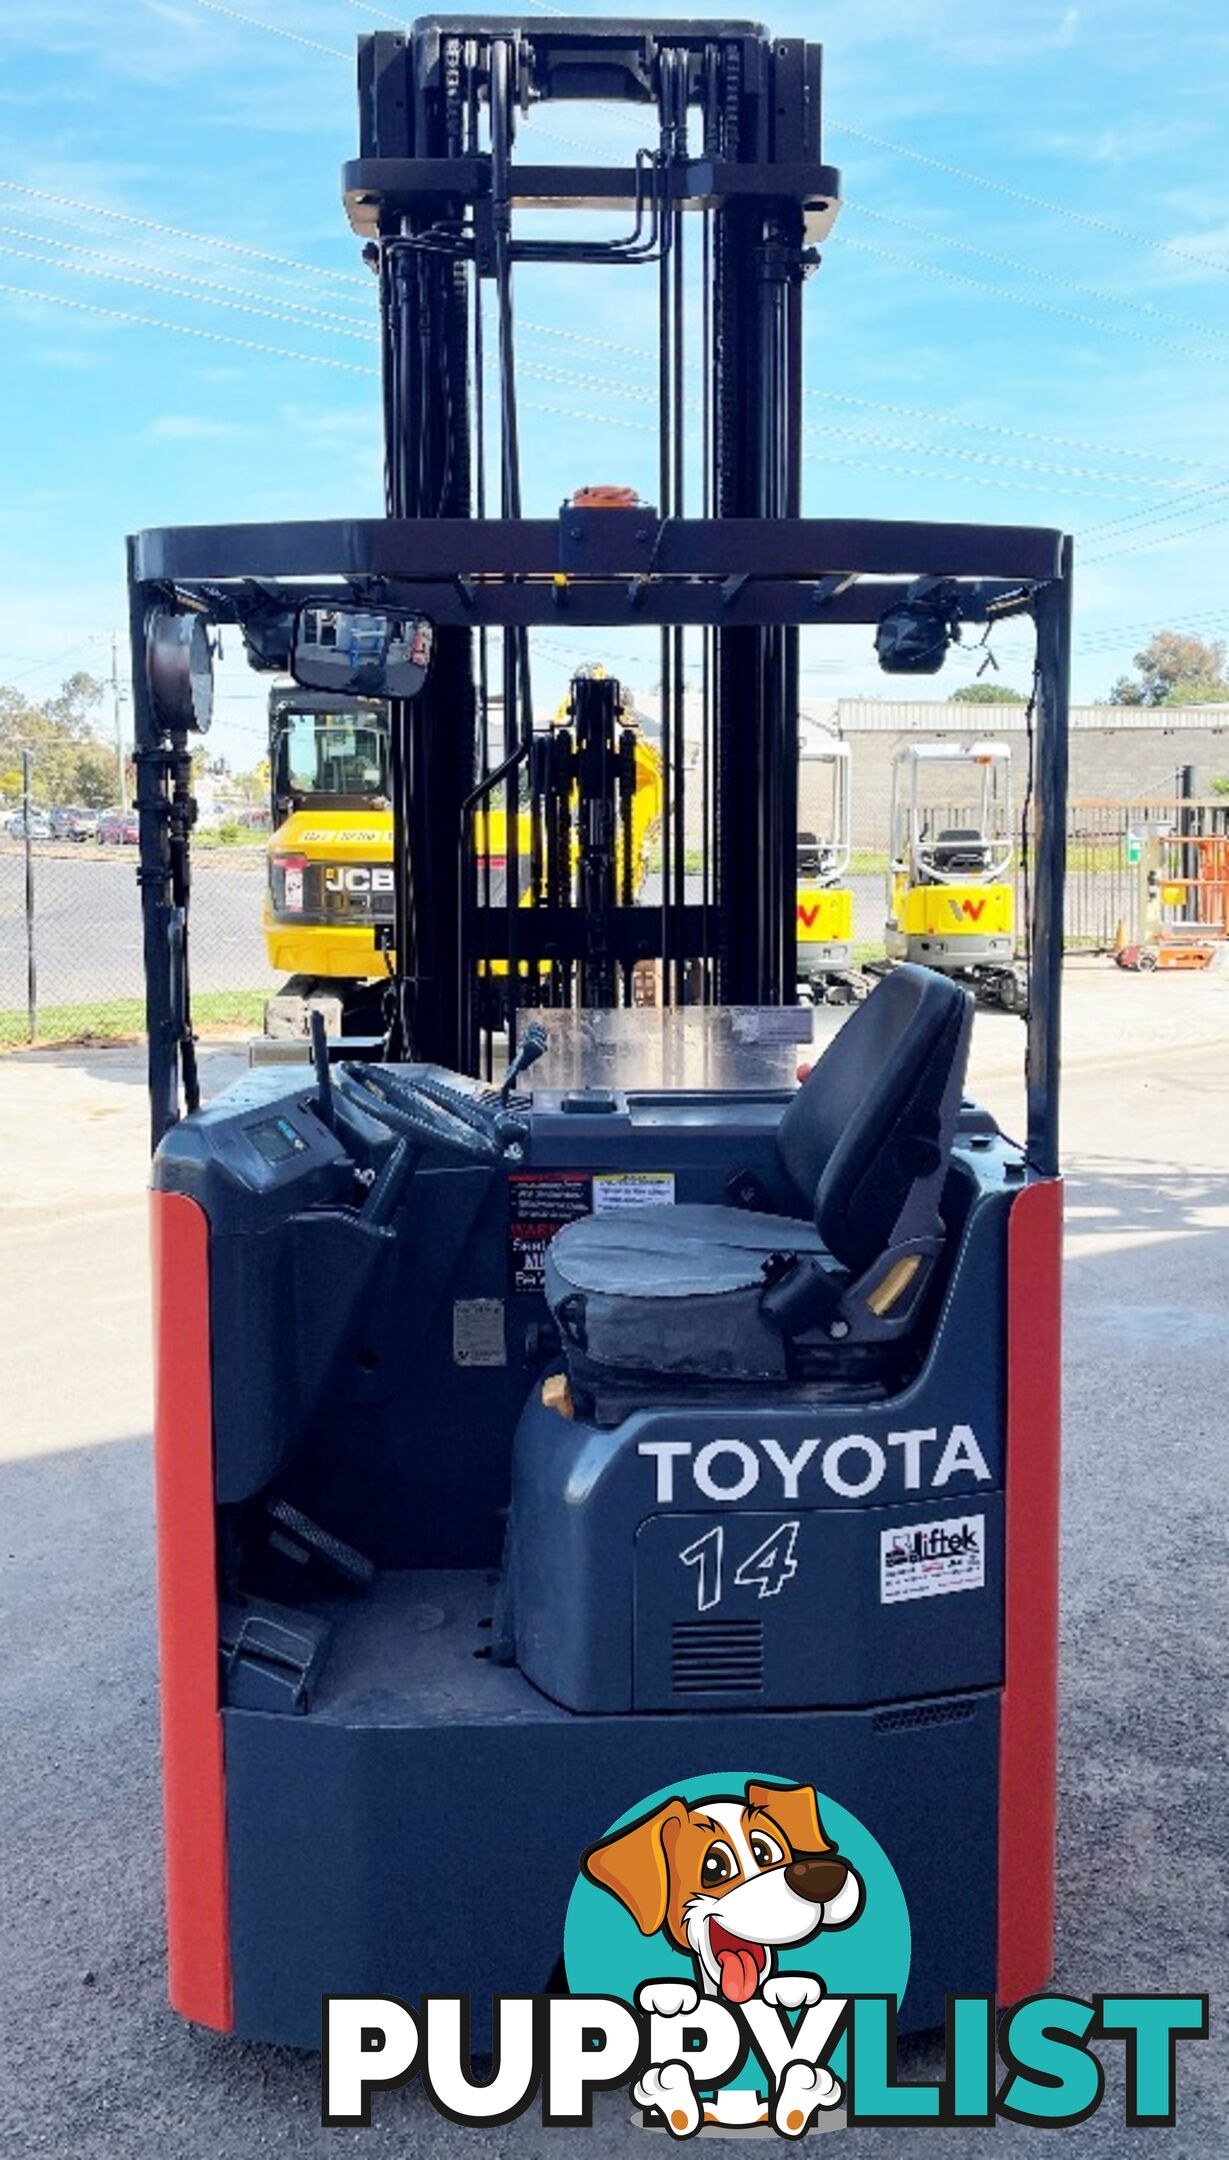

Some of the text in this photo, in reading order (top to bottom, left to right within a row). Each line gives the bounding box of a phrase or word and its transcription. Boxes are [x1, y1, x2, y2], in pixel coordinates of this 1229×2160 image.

[326, 868, 394, 891] JCB
[638, 1425, 992, 1503] TOYOTA
[679, 1520, 801, 1612] 14
